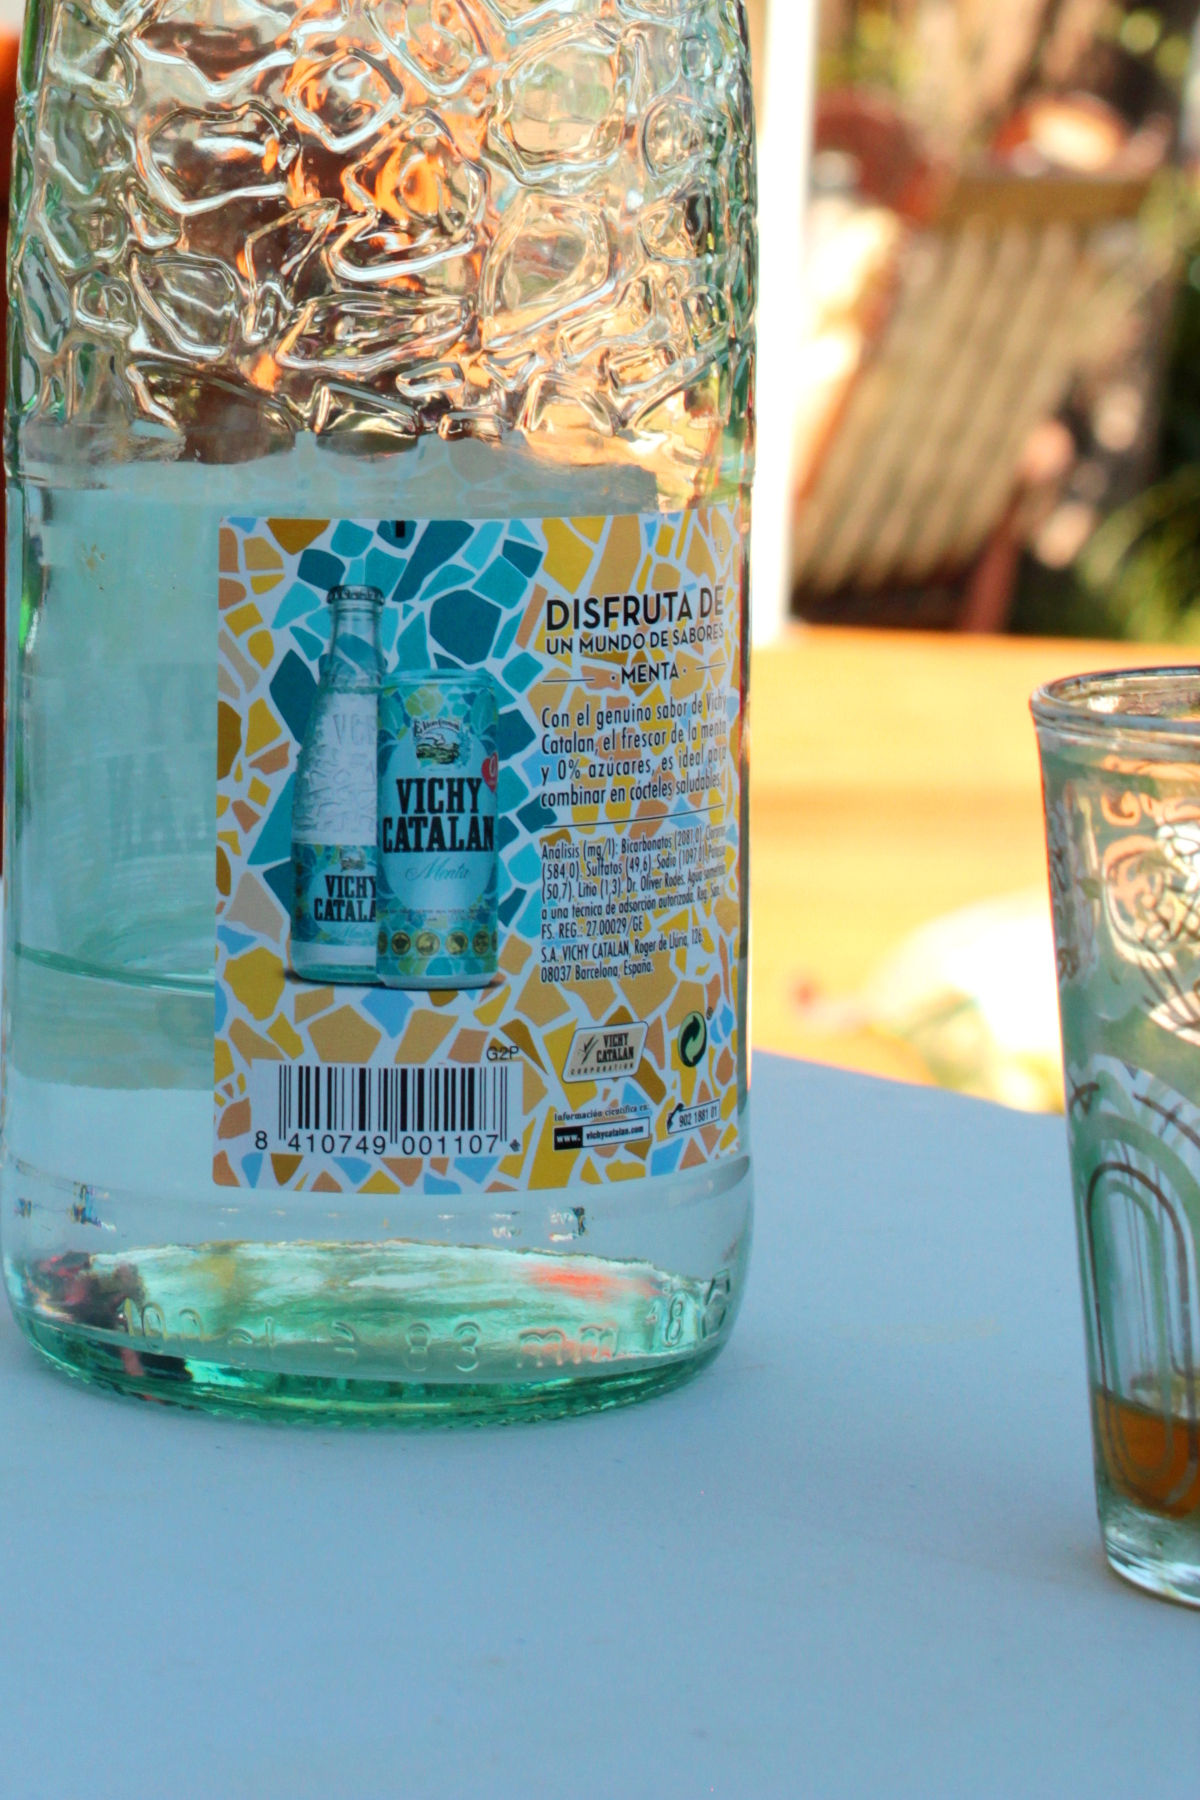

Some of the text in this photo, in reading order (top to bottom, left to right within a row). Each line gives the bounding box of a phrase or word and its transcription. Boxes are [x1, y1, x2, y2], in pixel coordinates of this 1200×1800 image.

[546, 584, 724, 631] DISFRUTA DE
[546, 622, 725, 655] UN MUNDO DE SABORES
[621, 662, 679, 684] MENTA
[541, 690, 727, 730] Con el genuino sabor de Vichy
[541, 719, 726, 756] Catalan, el frescor de la menta
[541, 767, 549, 786] y
[558, 759, 581, 781] 0%
[589, 757, 654, 778] azúcares,
[661, 756, 673, 772] es
[678, 748, 704, 769] ideal
[395, 777, 483, 815] VICHY
[541, 770, 722, 808] combinar en cócteles saludables.
[382, 815, 495, 854] CATALAN
[541, 843, 580, 860] Análisis
[621, 835, 672, 854] Bicarbonatos
[404, 857, 470, 881] Menta
[586, 859, 623, 878] Sulfatos
[657, 853, 676, 870] Sodio
[324, 875, 377, 899] VICHY
[578, 881, 598, 898] Litio
[627, 876, 638, 893] Dr.
[641, 875, 662, 893] Oliver
[541, 908, 547, 920] a
[551, 906, 569, 920] una
[572, 902, 602, 919] técnica
[605, 900, 616, 915] de
[619, 894, 656, 914] adsorción
[541, 923, 555, 940] FS.
[586, 915, 643, 937] 27.00029/GE
[541, 947, 559, 963] S.A.
[562, 945, 590, 961] VICHY
[592, 942, 632, 960] CATALAN,
[634, 938, 656, 957] Roger
[659, 935, 668, 951] de
[541, 960, 654, 984] 08037 Barcelona, España.
[603, 1032, 630, 1047] VICHY
[486, 1045, 520, 1062] G2P
[596, 1046, 635, 1064] CATALAN
[570, 1062, 634, 1076] CORPORATION
[679, 1113, 692, 1128] 902
[255, 1130, 499, 1155] 8 410749 001107
[556, 1125, 644, 1143] www. vichycatalan.com
